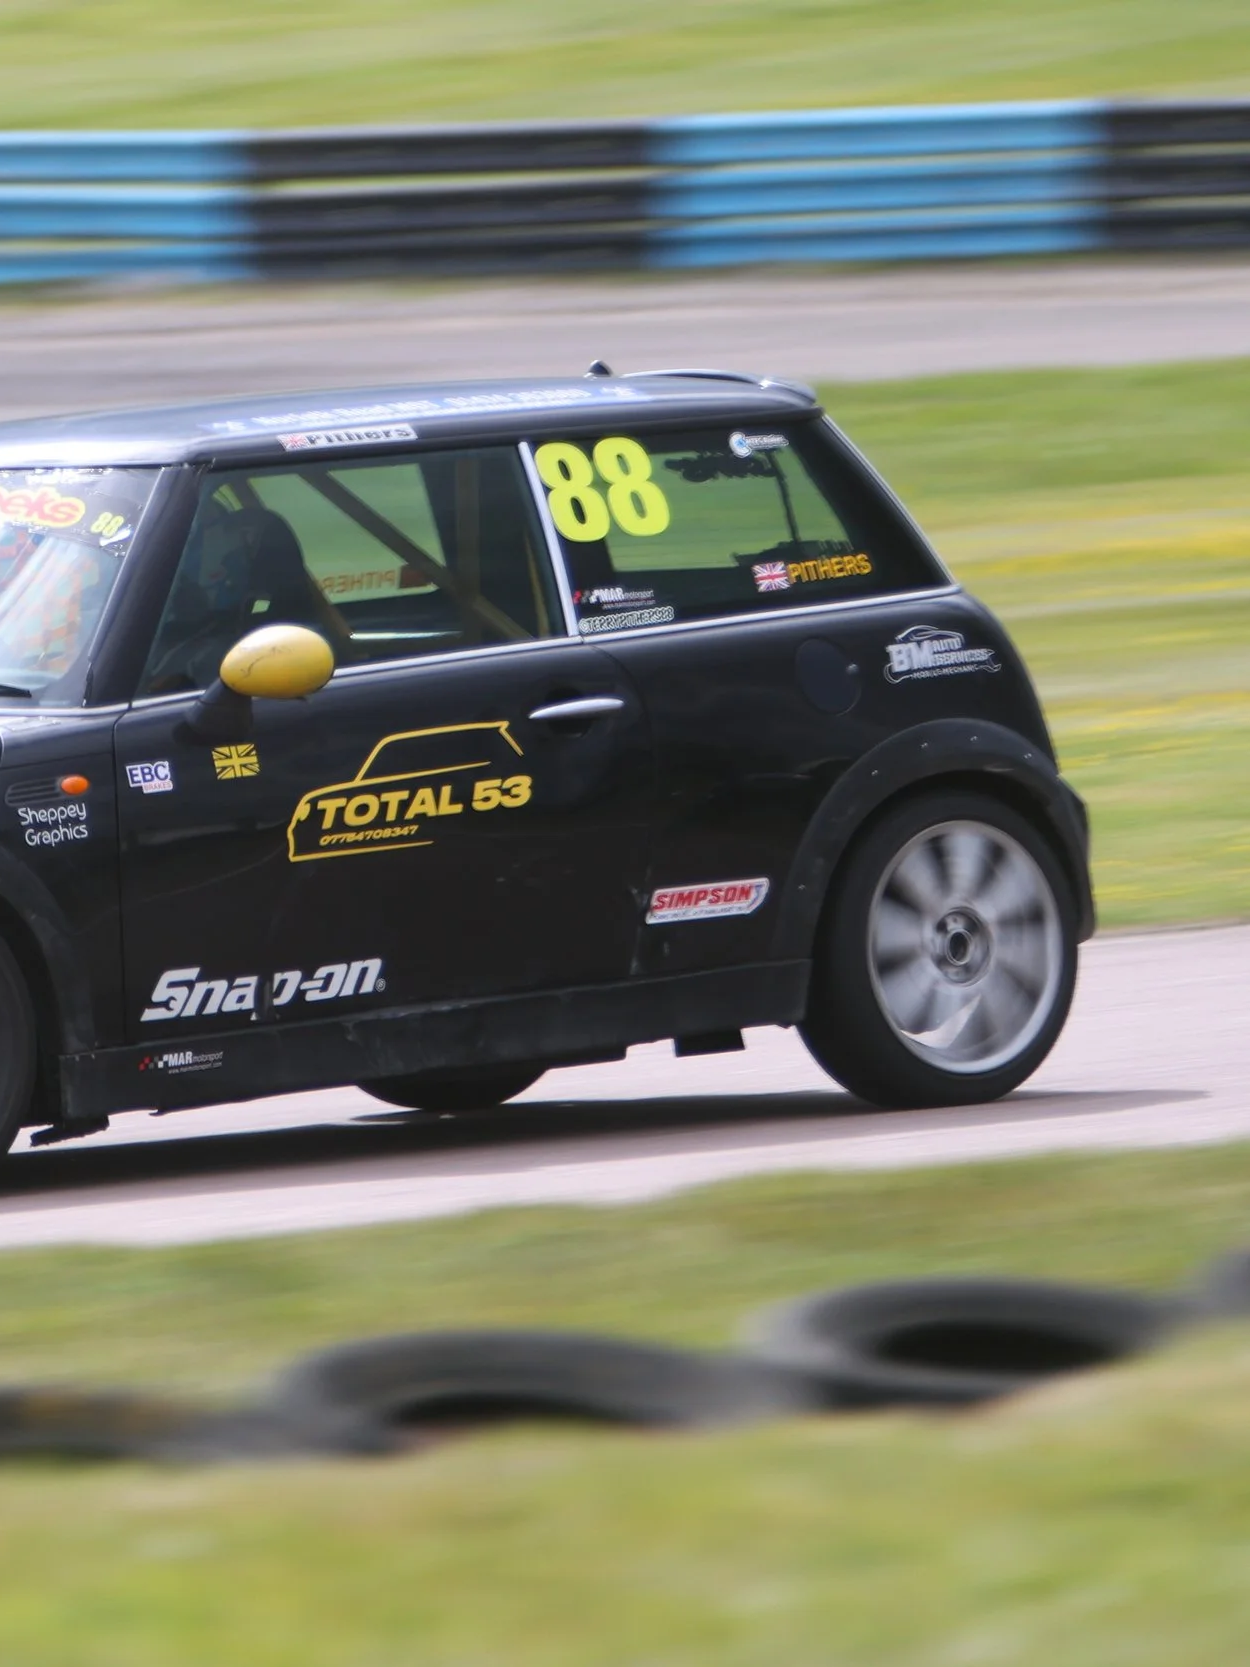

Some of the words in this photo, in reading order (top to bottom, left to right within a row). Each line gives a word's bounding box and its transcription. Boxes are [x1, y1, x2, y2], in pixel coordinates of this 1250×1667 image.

[534, 436, 670, 543] 88
[90, 511, 124, 538] 88
[787, 553, 872, 584] PITHERS
[886, 640, 933, 673] BM
[933, 637, 962, 653] AUTO
[128, 762, 170, 785] EBC
[18, 802, 87, 826] Sheppey
[317, 785, 463, 830] TOTAL
[471, 775, 533, 811] 53
[25, 823, 88, 847] Graphics
[653, 885, 754, 910] SIMPSON
[168, 1051, 192, 1067] MAR
